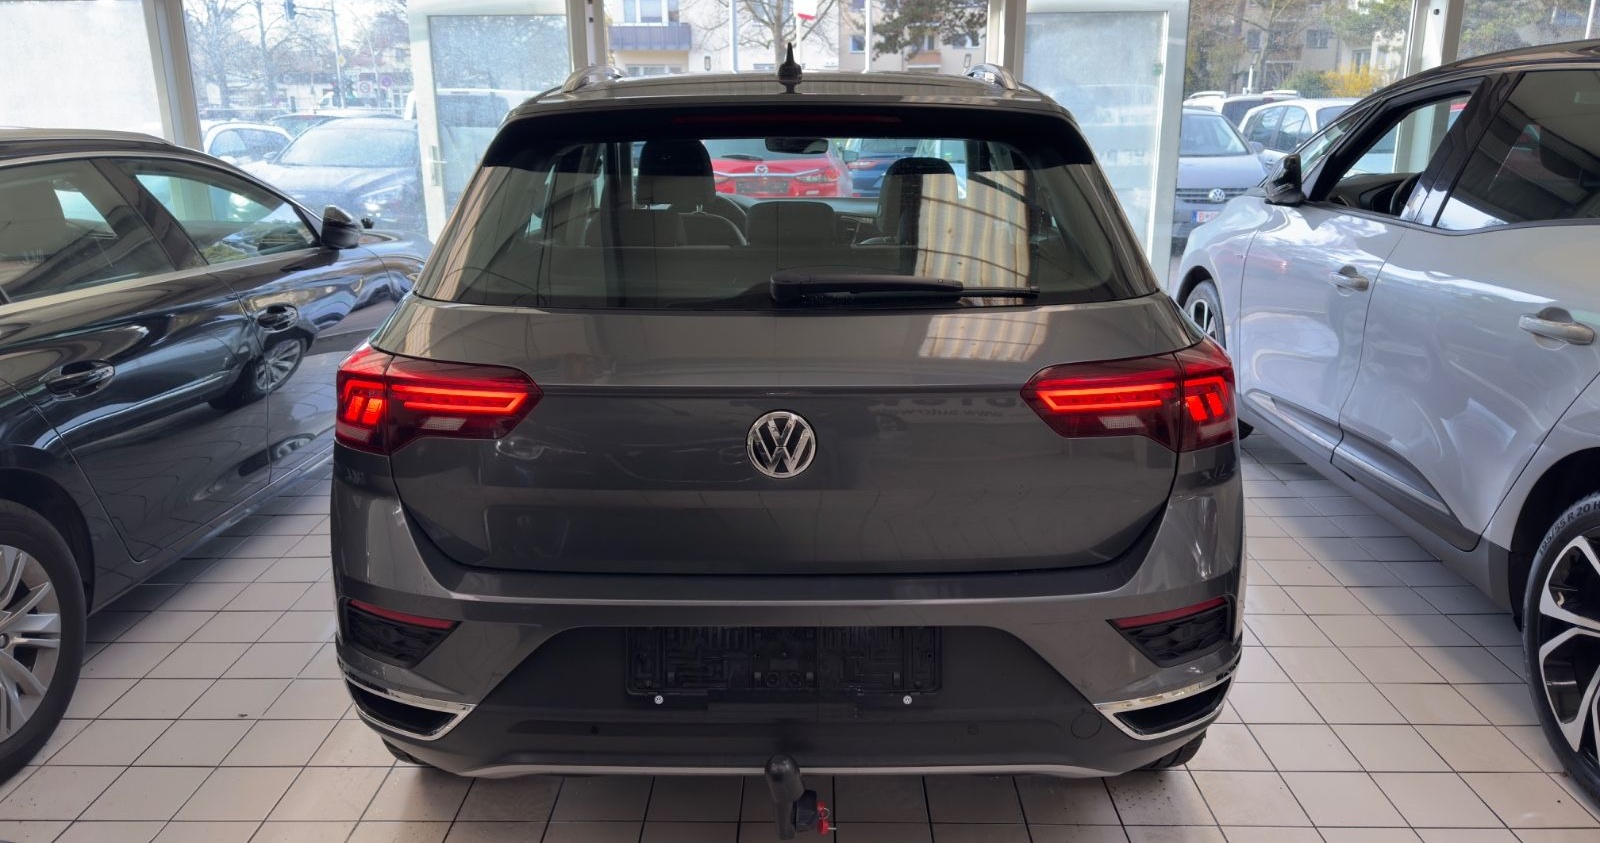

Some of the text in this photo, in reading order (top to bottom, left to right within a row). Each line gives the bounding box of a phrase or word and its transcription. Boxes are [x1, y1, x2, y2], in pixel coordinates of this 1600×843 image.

[747, 411, 816, 479] VW
[1540, 518, 1566, 555] 195/55
[1567, 512, 1575, 522] R
[1576, 504, 1591, 517] 20
